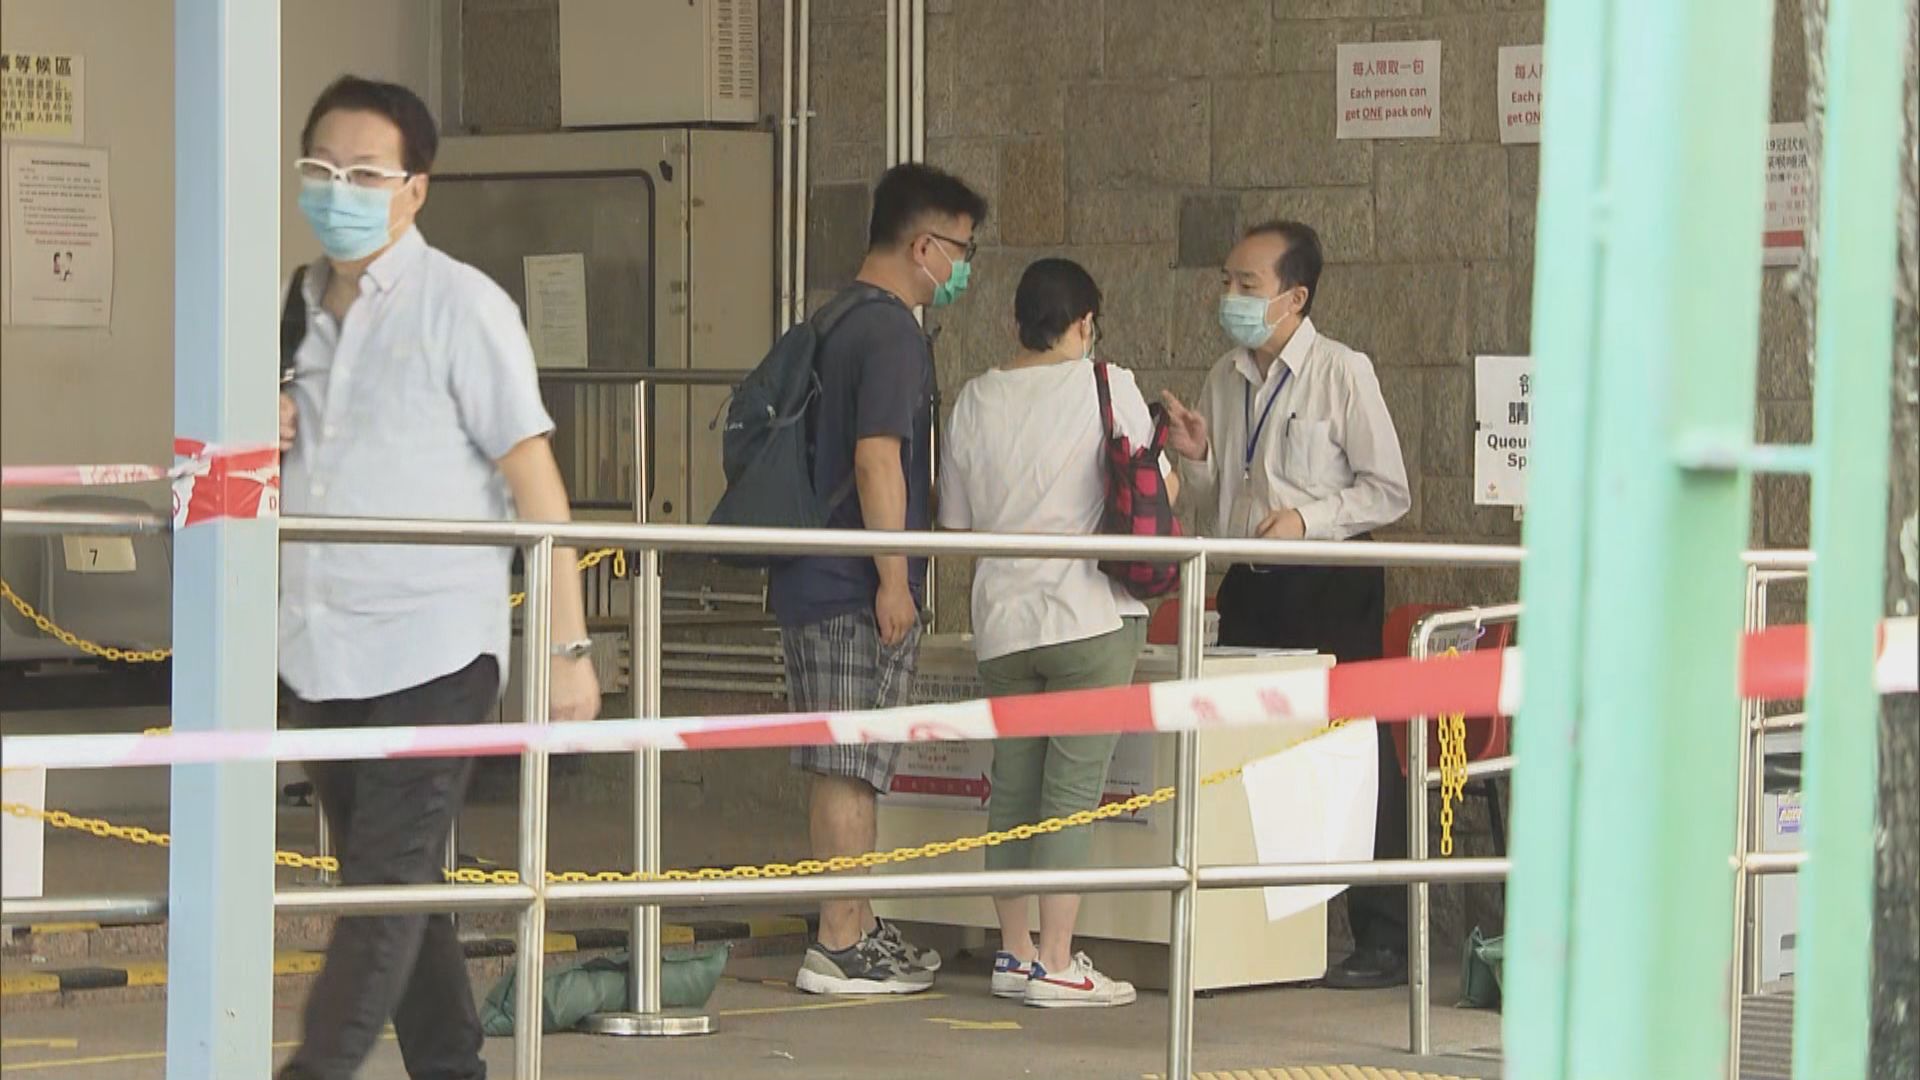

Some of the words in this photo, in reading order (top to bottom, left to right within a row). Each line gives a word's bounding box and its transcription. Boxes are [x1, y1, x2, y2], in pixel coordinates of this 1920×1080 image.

[1353, 59, 1424, 76] 每人限取一包
[1350, 87, 1372, 99] Each
[1374, 87, 1407, 100] person
[1409, 87, 1426, 97] can
[1511, 91, 1534, 103] Each
[1345, 108, 1360, 121] get
[1362, 106, 1383, 120] ONE
[1385, 105, 1408, 120] pack
[1410, 104, 1432, 119] only
[1507, 112, 1522, 126] get
[89, 549, 99, 566] 7
